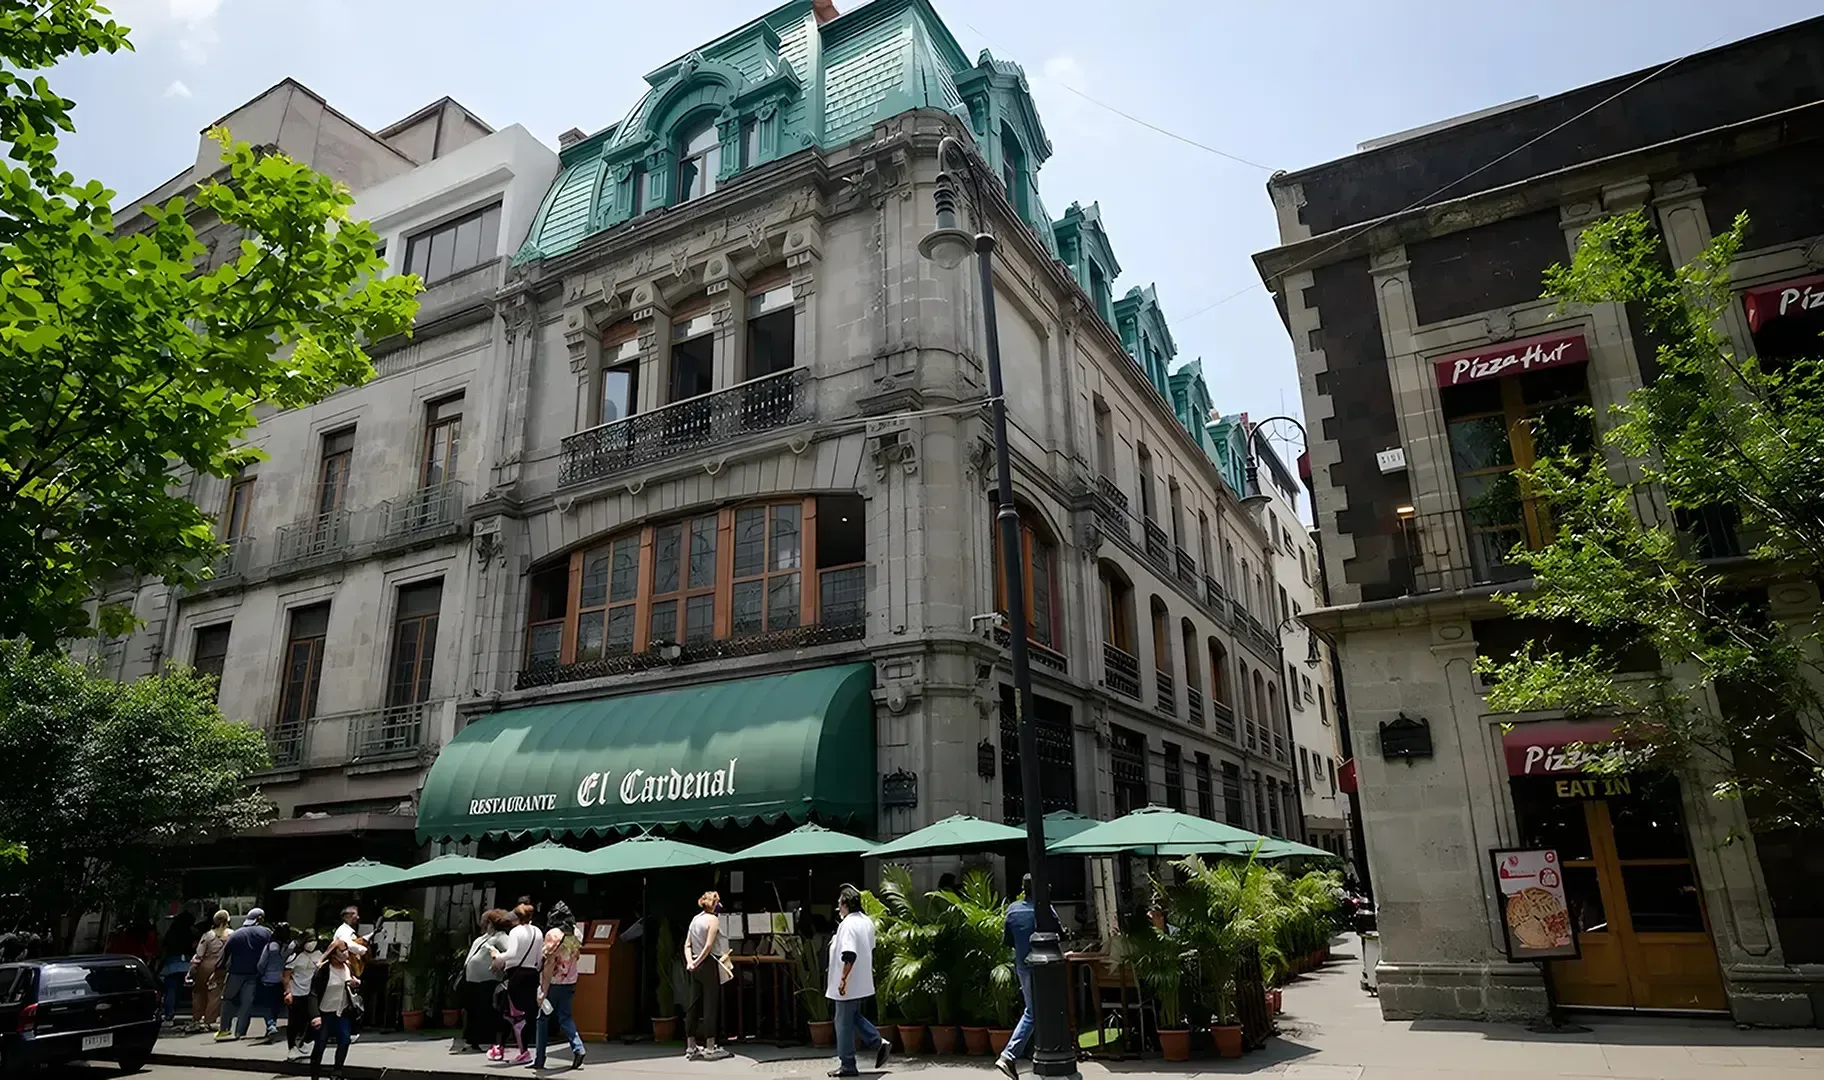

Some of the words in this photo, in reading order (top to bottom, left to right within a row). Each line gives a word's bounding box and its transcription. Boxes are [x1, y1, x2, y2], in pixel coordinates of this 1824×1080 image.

[1452, 357, 1519, 384] Pizza
[1520, 342, 1572, 369] Hut
[469, 794, 557, 815] RESTAURANTE
[576, 770, 611, 808] El
[619, 756, 739, 806] Cardenal
[1556, 779, 1597, 797] EAT
[1603, 777, 1632, 796] IN
